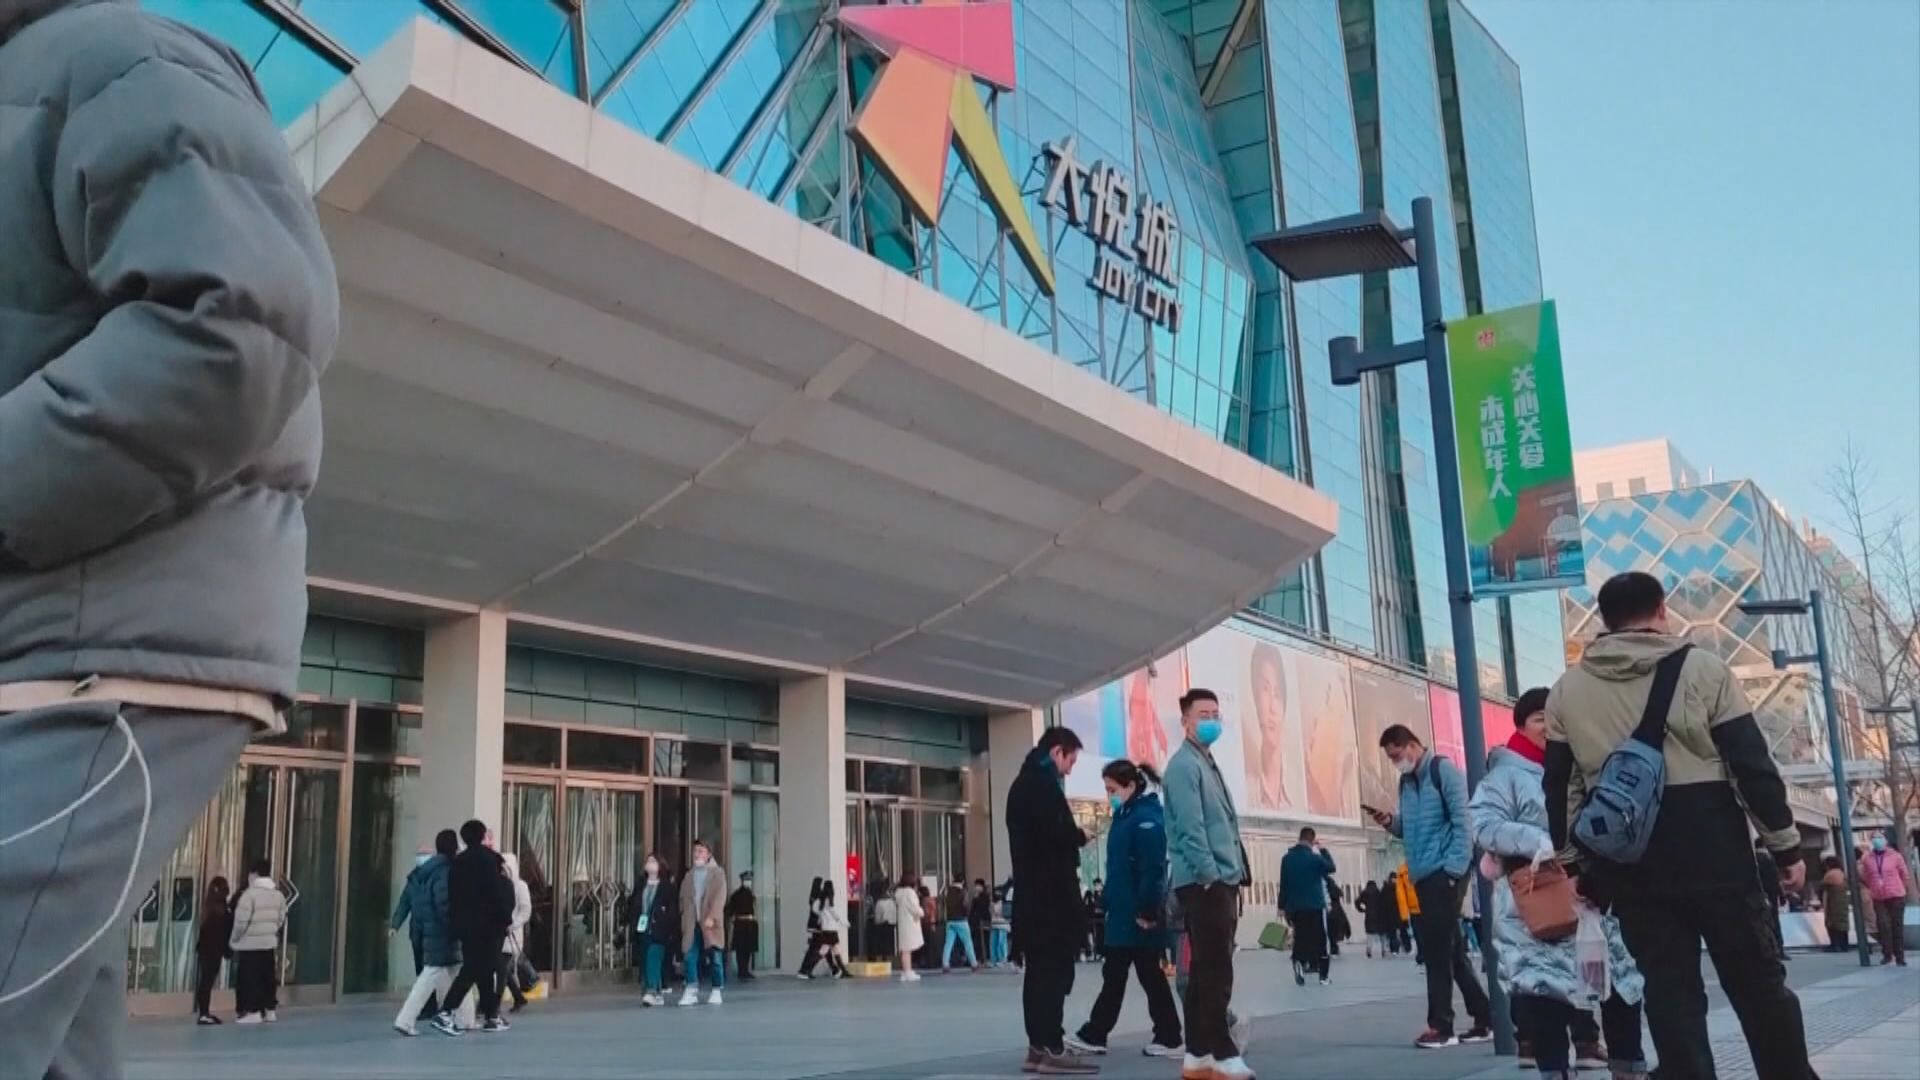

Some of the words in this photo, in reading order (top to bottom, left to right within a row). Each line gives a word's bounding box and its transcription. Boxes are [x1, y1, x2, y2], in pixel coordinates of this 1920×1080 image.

[1039, 134, 1179, 290] 大悦城
[1087, 251, 1136, 306] JOY
[1135, 279, 1183, 334] CITY
[1480, 394, 1513, 500] 未成年人
[1511, 362, 1545, 469] 关心关爱
